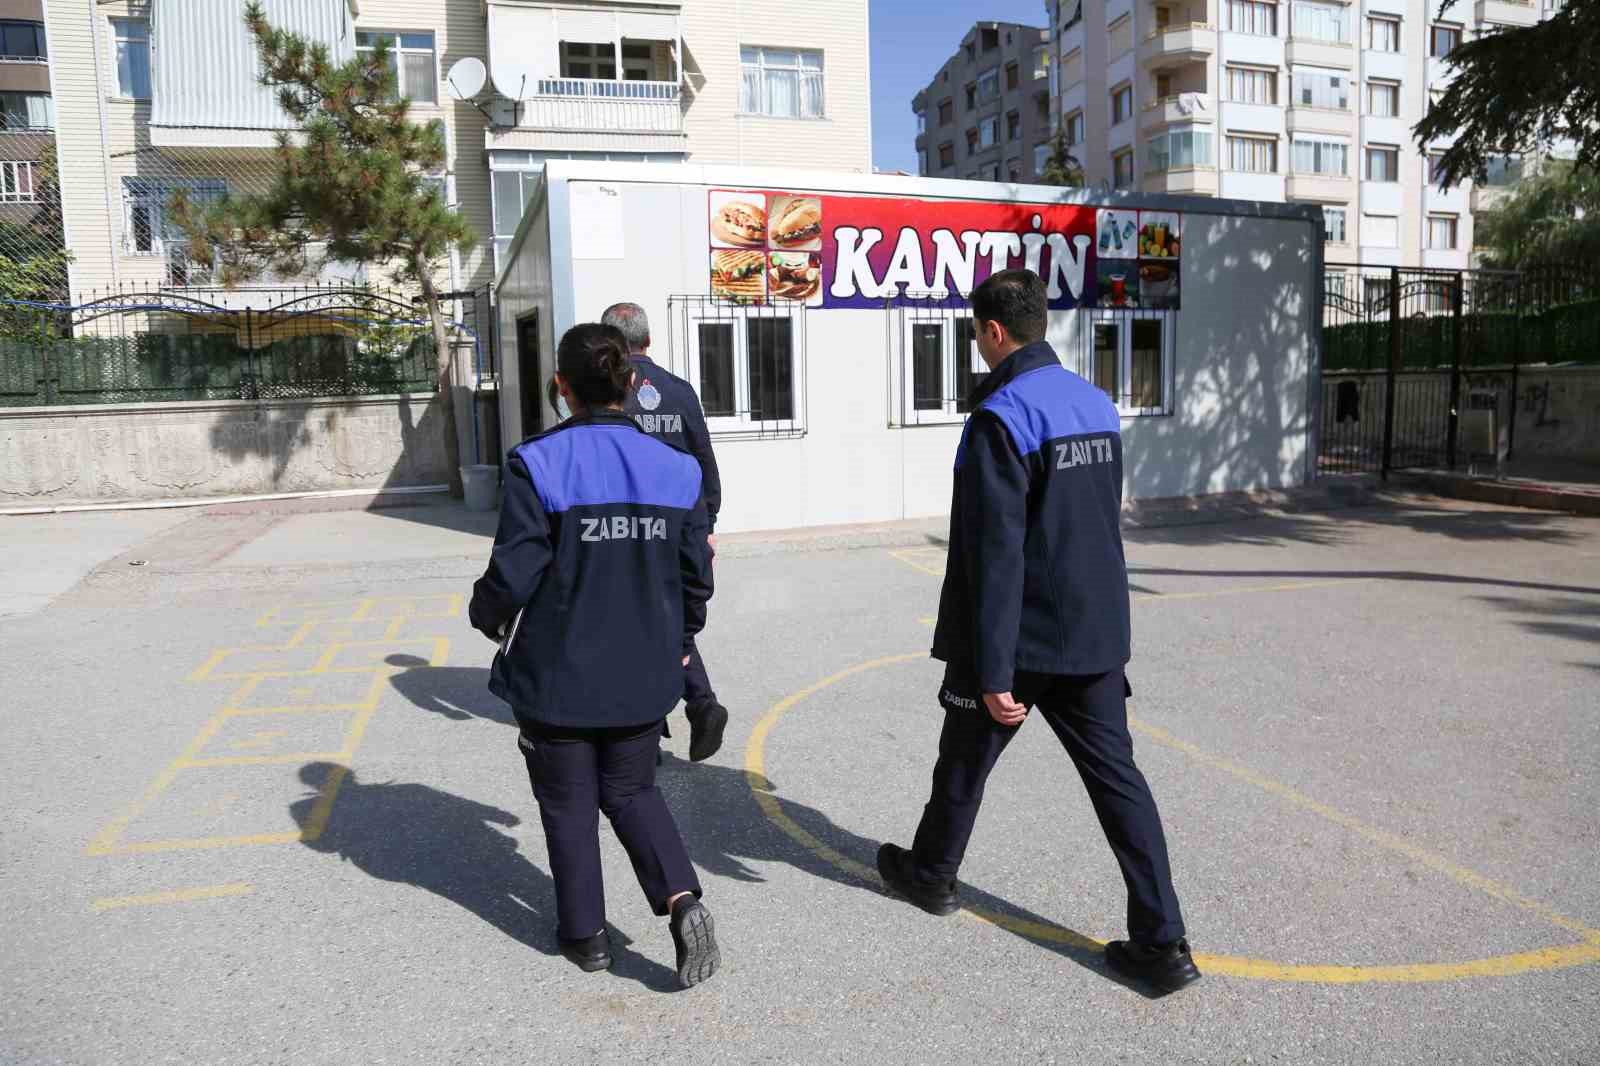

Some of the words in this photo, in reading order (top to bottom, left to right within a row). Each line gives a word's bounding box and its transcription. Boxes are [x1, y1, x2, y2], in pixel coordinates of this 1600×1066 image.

[830, 213, 1091, 299] KANTİN
[580, 516, 667, 541] ZABITA
[944, 690, 977, 709] ZABITA
